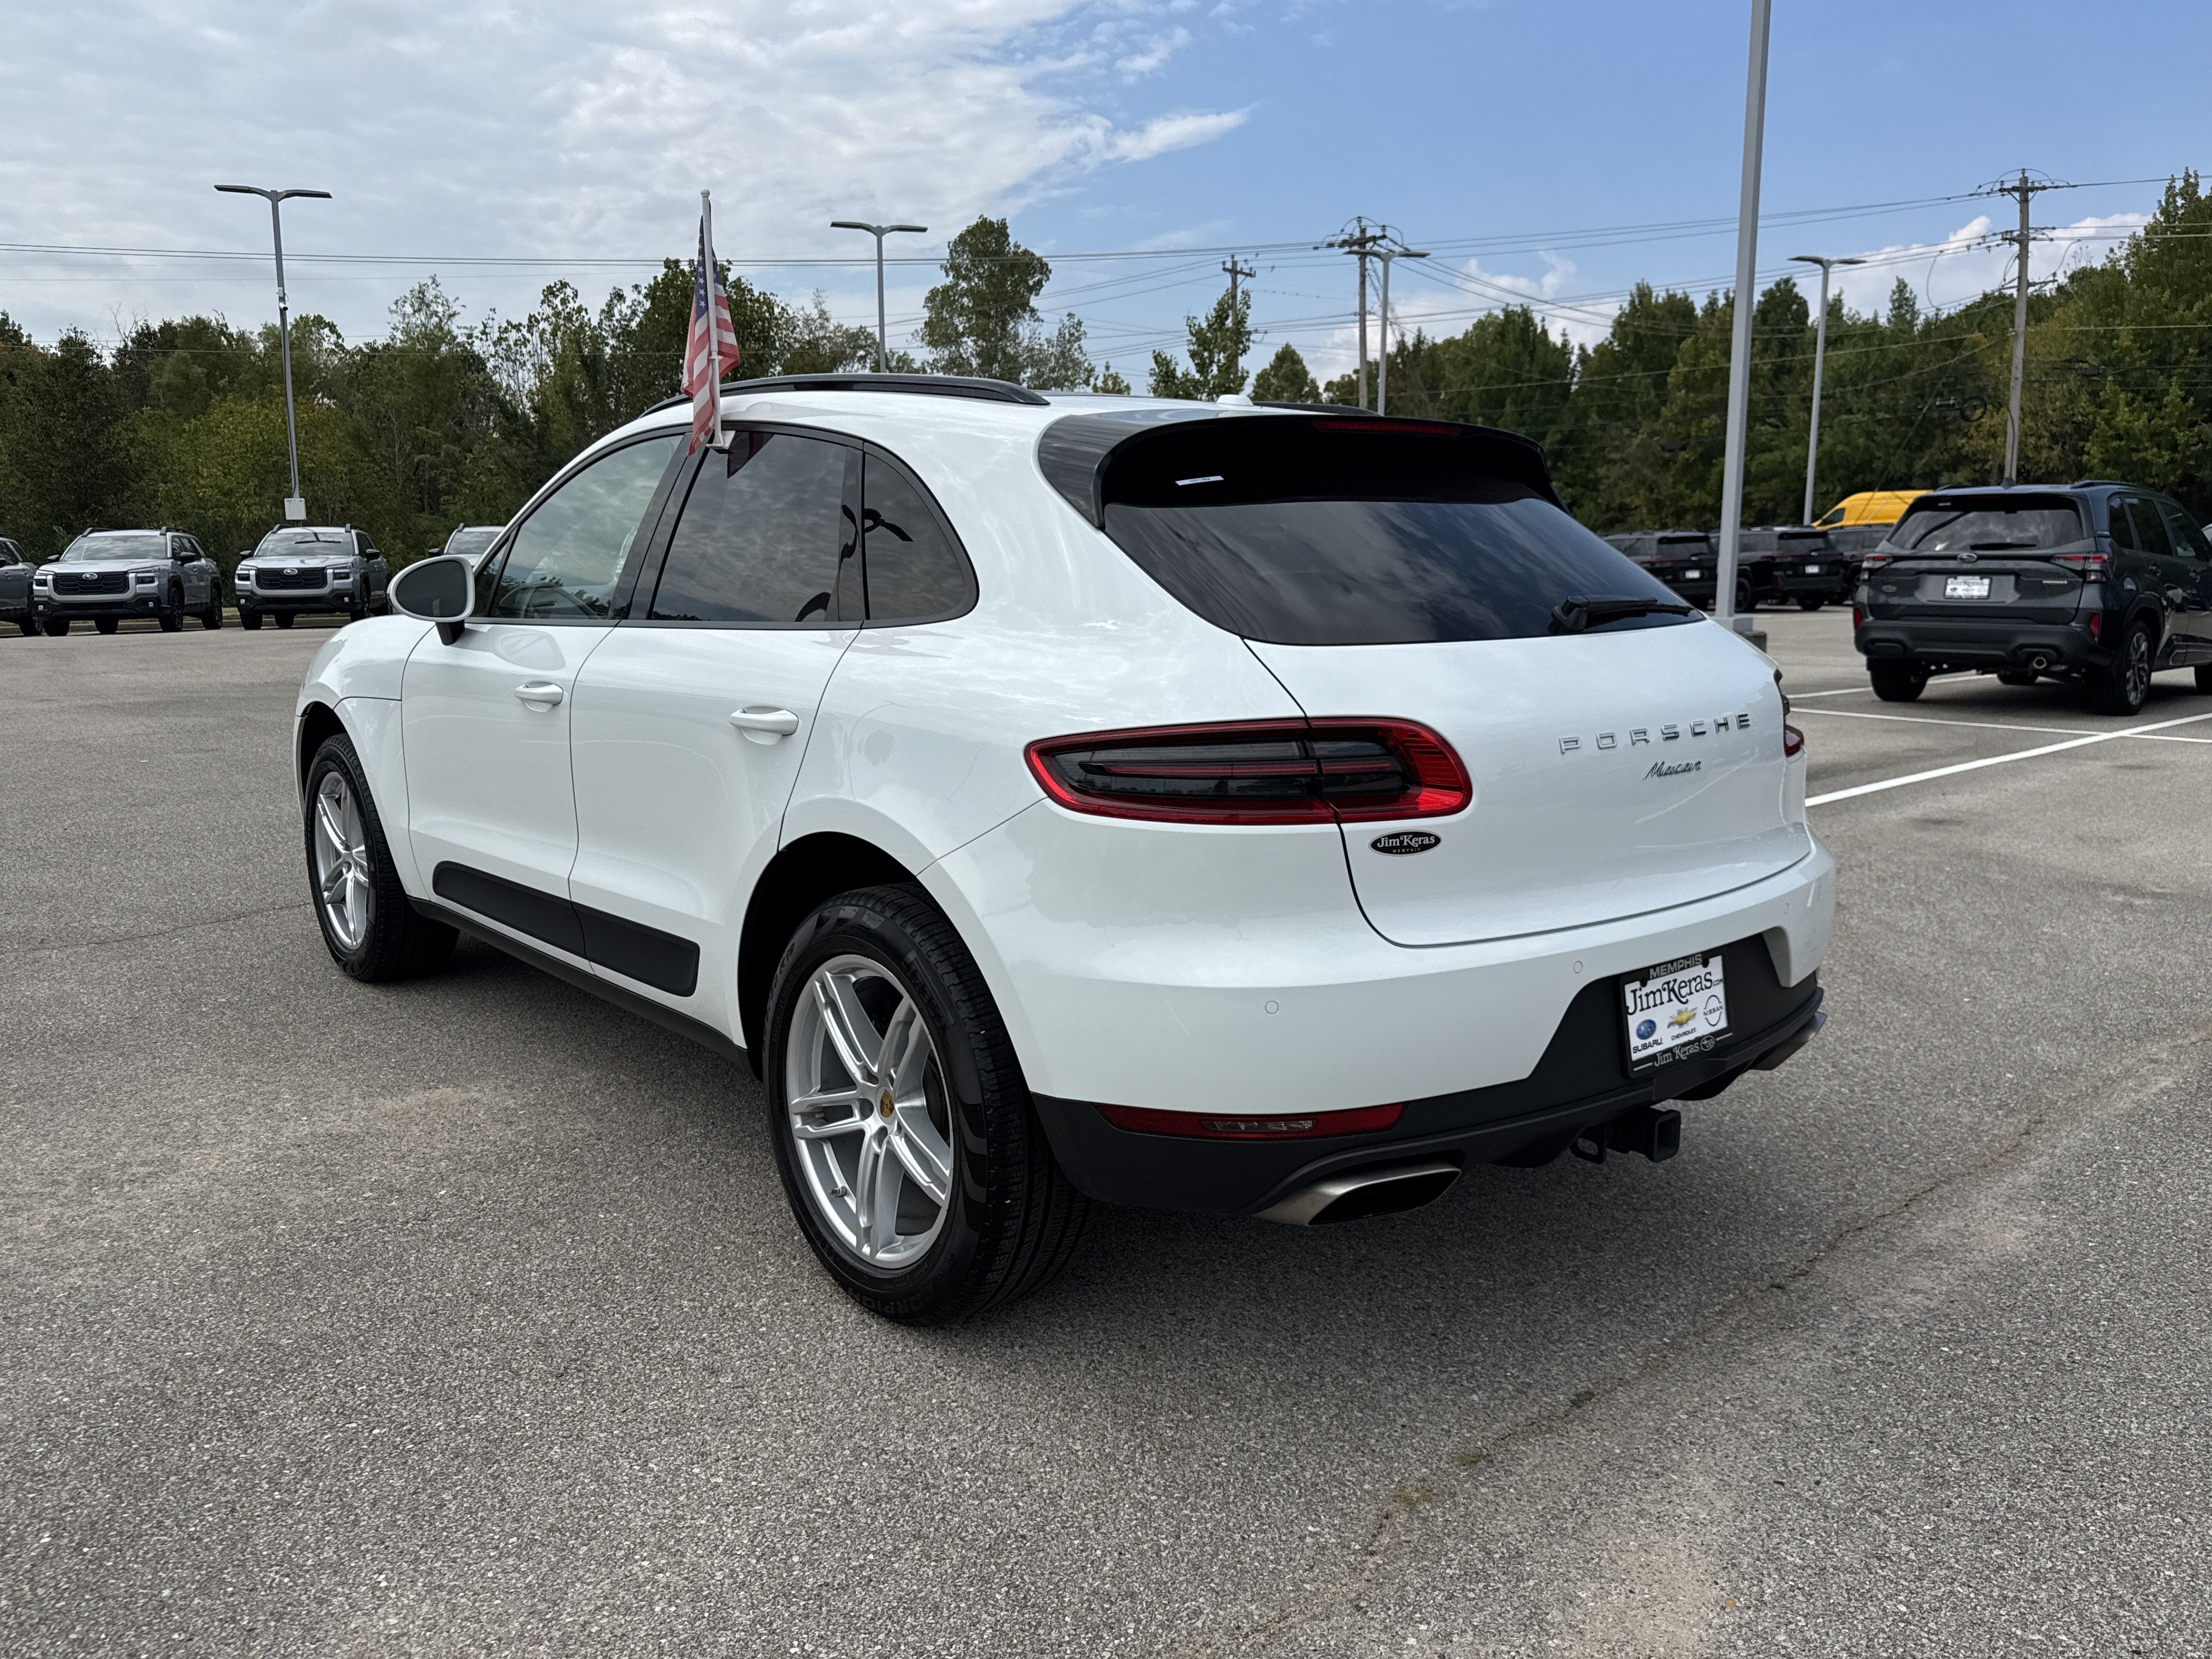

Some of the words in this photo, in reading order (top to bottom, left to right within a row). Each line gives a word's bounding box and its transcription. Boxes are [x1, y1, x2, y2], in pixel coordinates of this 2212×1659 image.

[1559, 714, 1750, 754] PORSCHE
[1643, 760, 1701, 780] Macan
[1377, 837, 1400, 847] Jim
[1400, 836, 1435, 847] Keras
[1649, 954, 1702, 979] MEMPHIS
[1703, 1005, 1723, 1016] NISSAN
[1671, 1028, 1696, 1041] CHEVROLET
[1633, 1037, 1663, 1053] SUBARU
[1654, 1053, 1673, 1067] Jim
[1673, 1042, 1700, 1060] Keras
